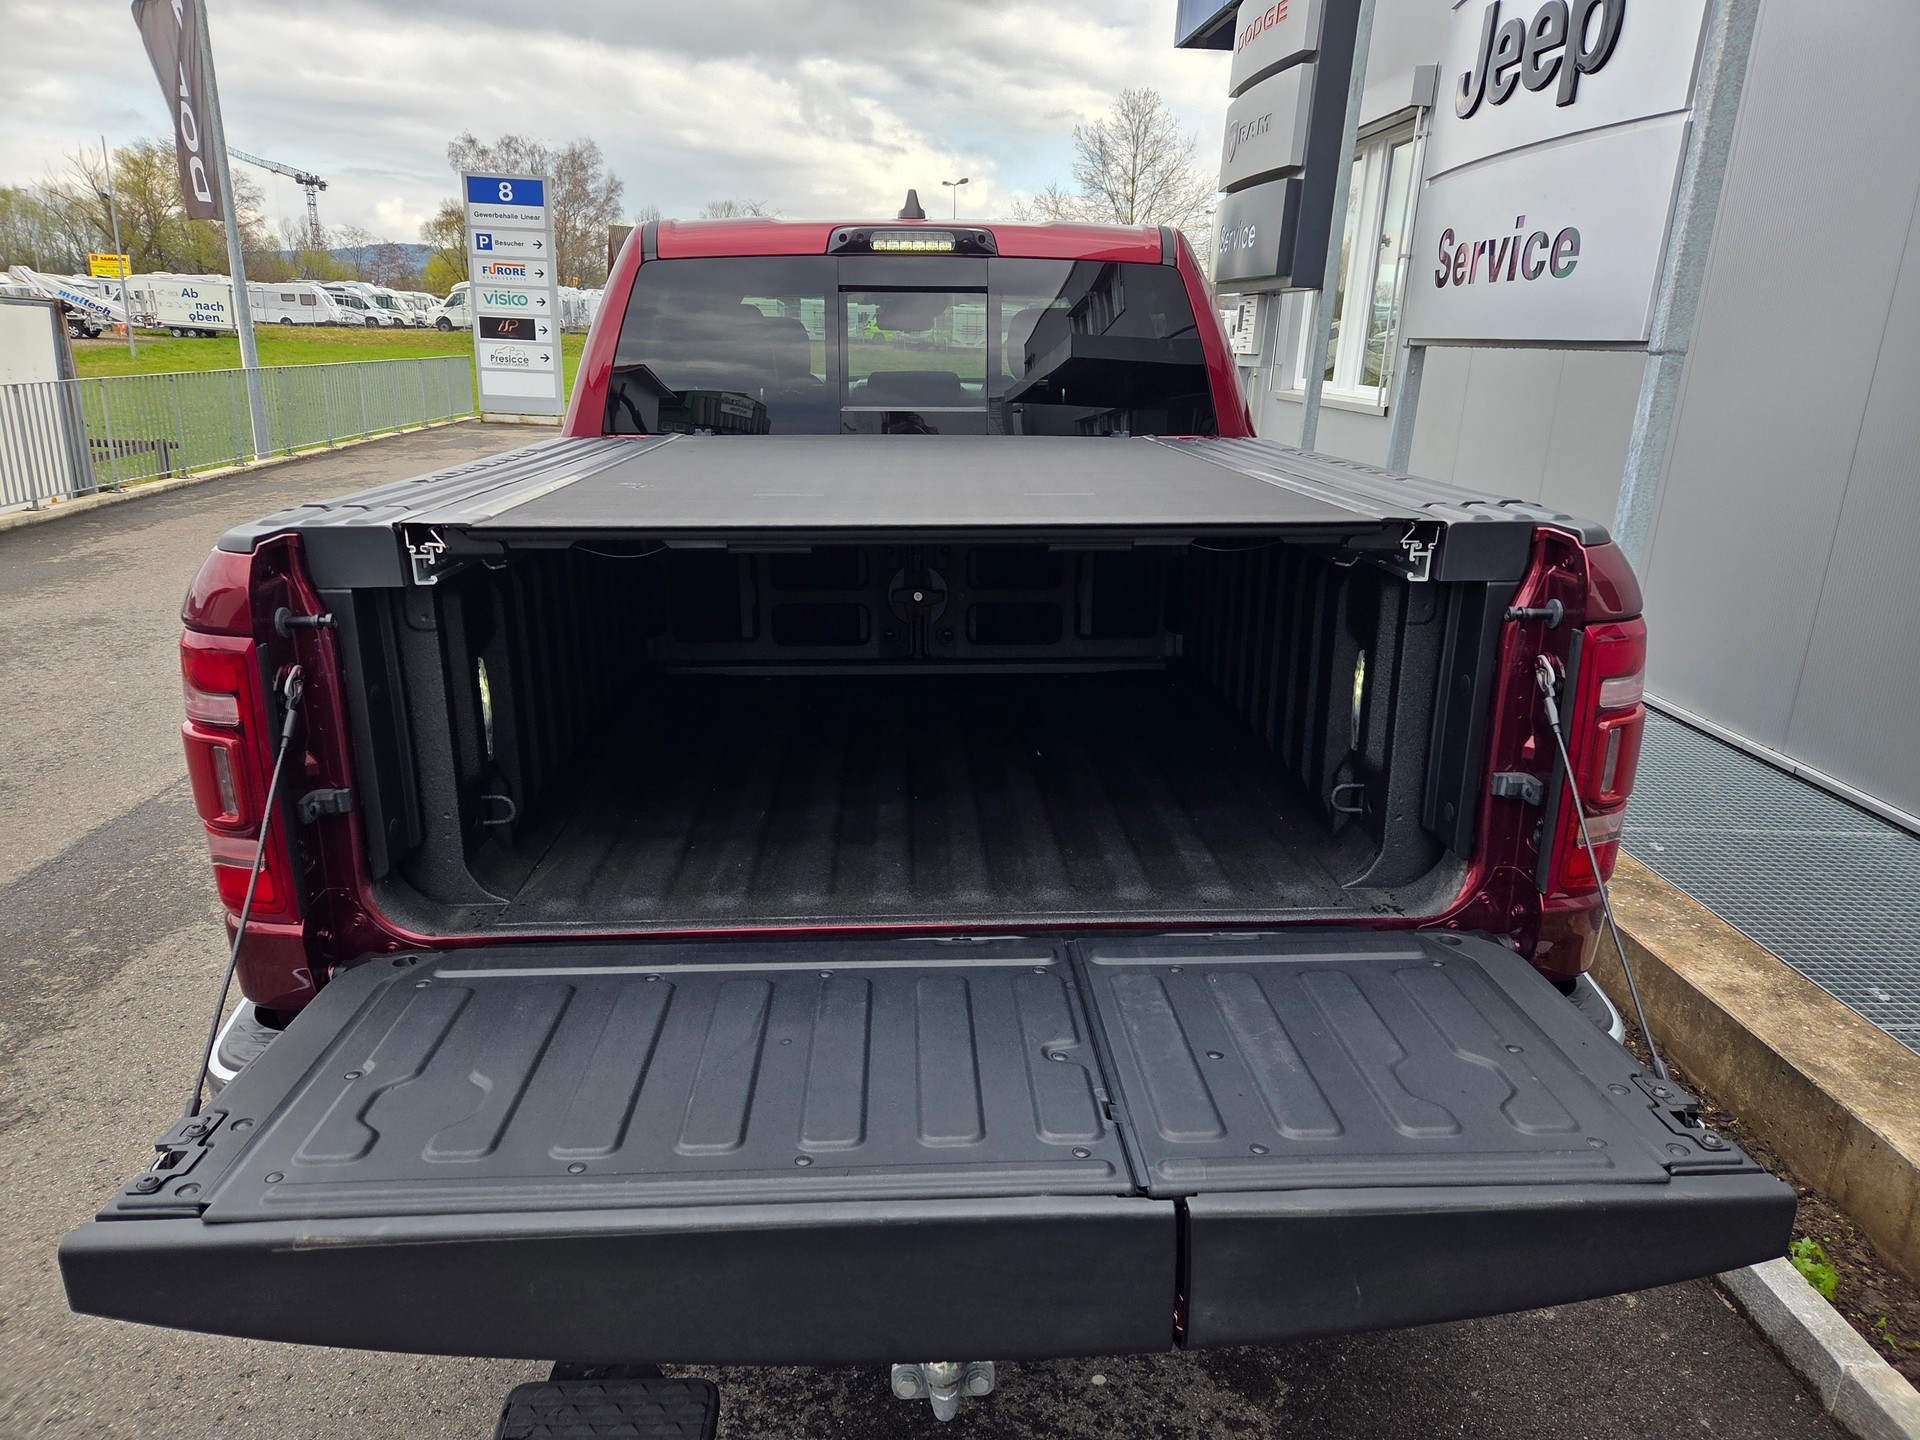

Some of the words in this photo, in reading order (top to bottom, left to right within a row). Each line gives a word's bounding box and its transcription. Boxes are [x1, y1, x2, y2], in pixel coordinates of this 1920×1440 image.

[1238, 0, 1289, 54] DODGE
[1455, 0, 1626, 119] Jeep
[171, 0, 212, 202] DO
[1238, 113, 1272, 145] RAM
[498, 182, 513, 201] 8
[474, 211, 518, 220] Gewerbehalle
[520, 213, 541, 221] Linear
[479, 235, 489, 248] P
[494, 239, 524, 247] Besucher
[1219, 220, 1256, 254] Service
[1434, 215, 1582, 289] Service
[482, 263, 526, 276] FURORE
[58, 290, 111, 316] maltech
[181, 288, 199, 299] Ab
[195, 301, 224, 312] nach
[189, 311, 224, 323] oben.
[490, 354, 529, 364] Presicce
